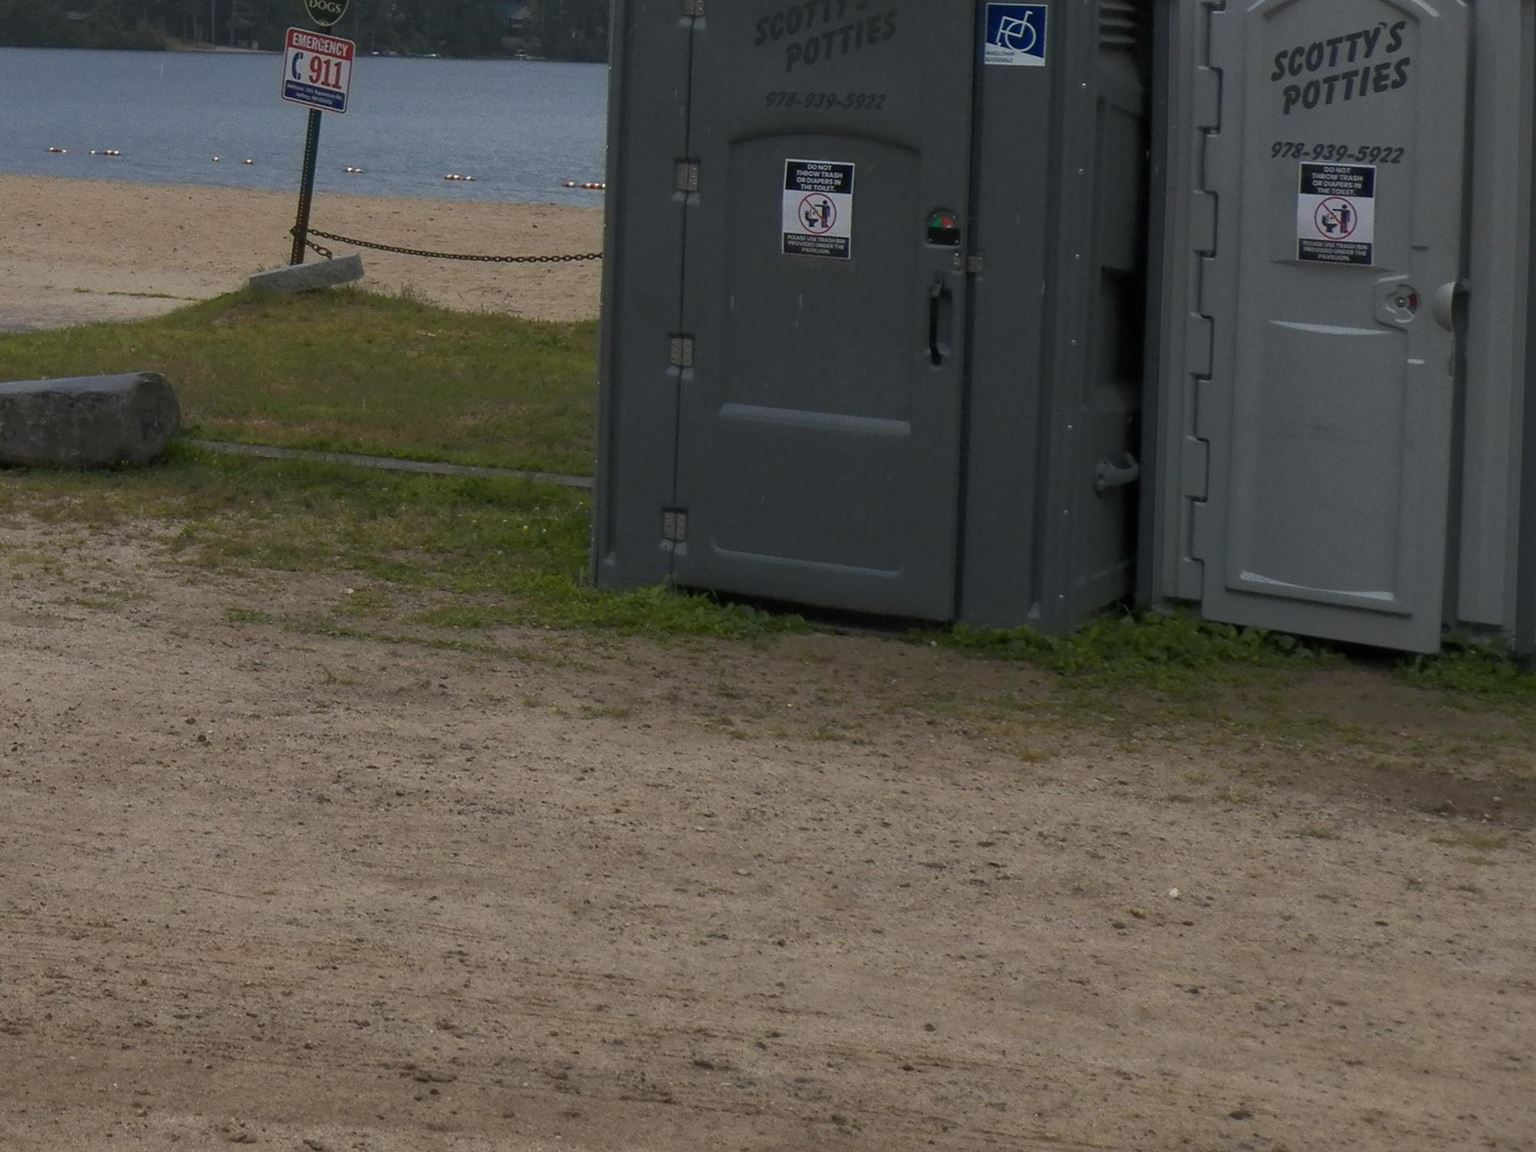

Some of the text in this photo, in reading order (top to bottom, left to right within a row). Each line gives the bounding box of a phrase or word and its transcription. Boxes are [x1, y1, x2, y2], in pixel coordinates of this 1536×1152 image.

[292, 32, 348, 57] EMERGENCY
[785, 8, 898, 73] POTTIES
[1271, 20, 1406, 82] SCOTTY'S
[309, 55, 342, 90] 911
[1283, 56, 1410, 115] POTTIES
[765, 91, 887, 110] 978-939-5922
[1271, 141, 1405, 164] 978-939-5922
[807, 177, 833, 185] DIAPERS
[1312, 172, 1363, 182] THROW TRASH
[1323, 180, 1353, 188] DIAPERS
